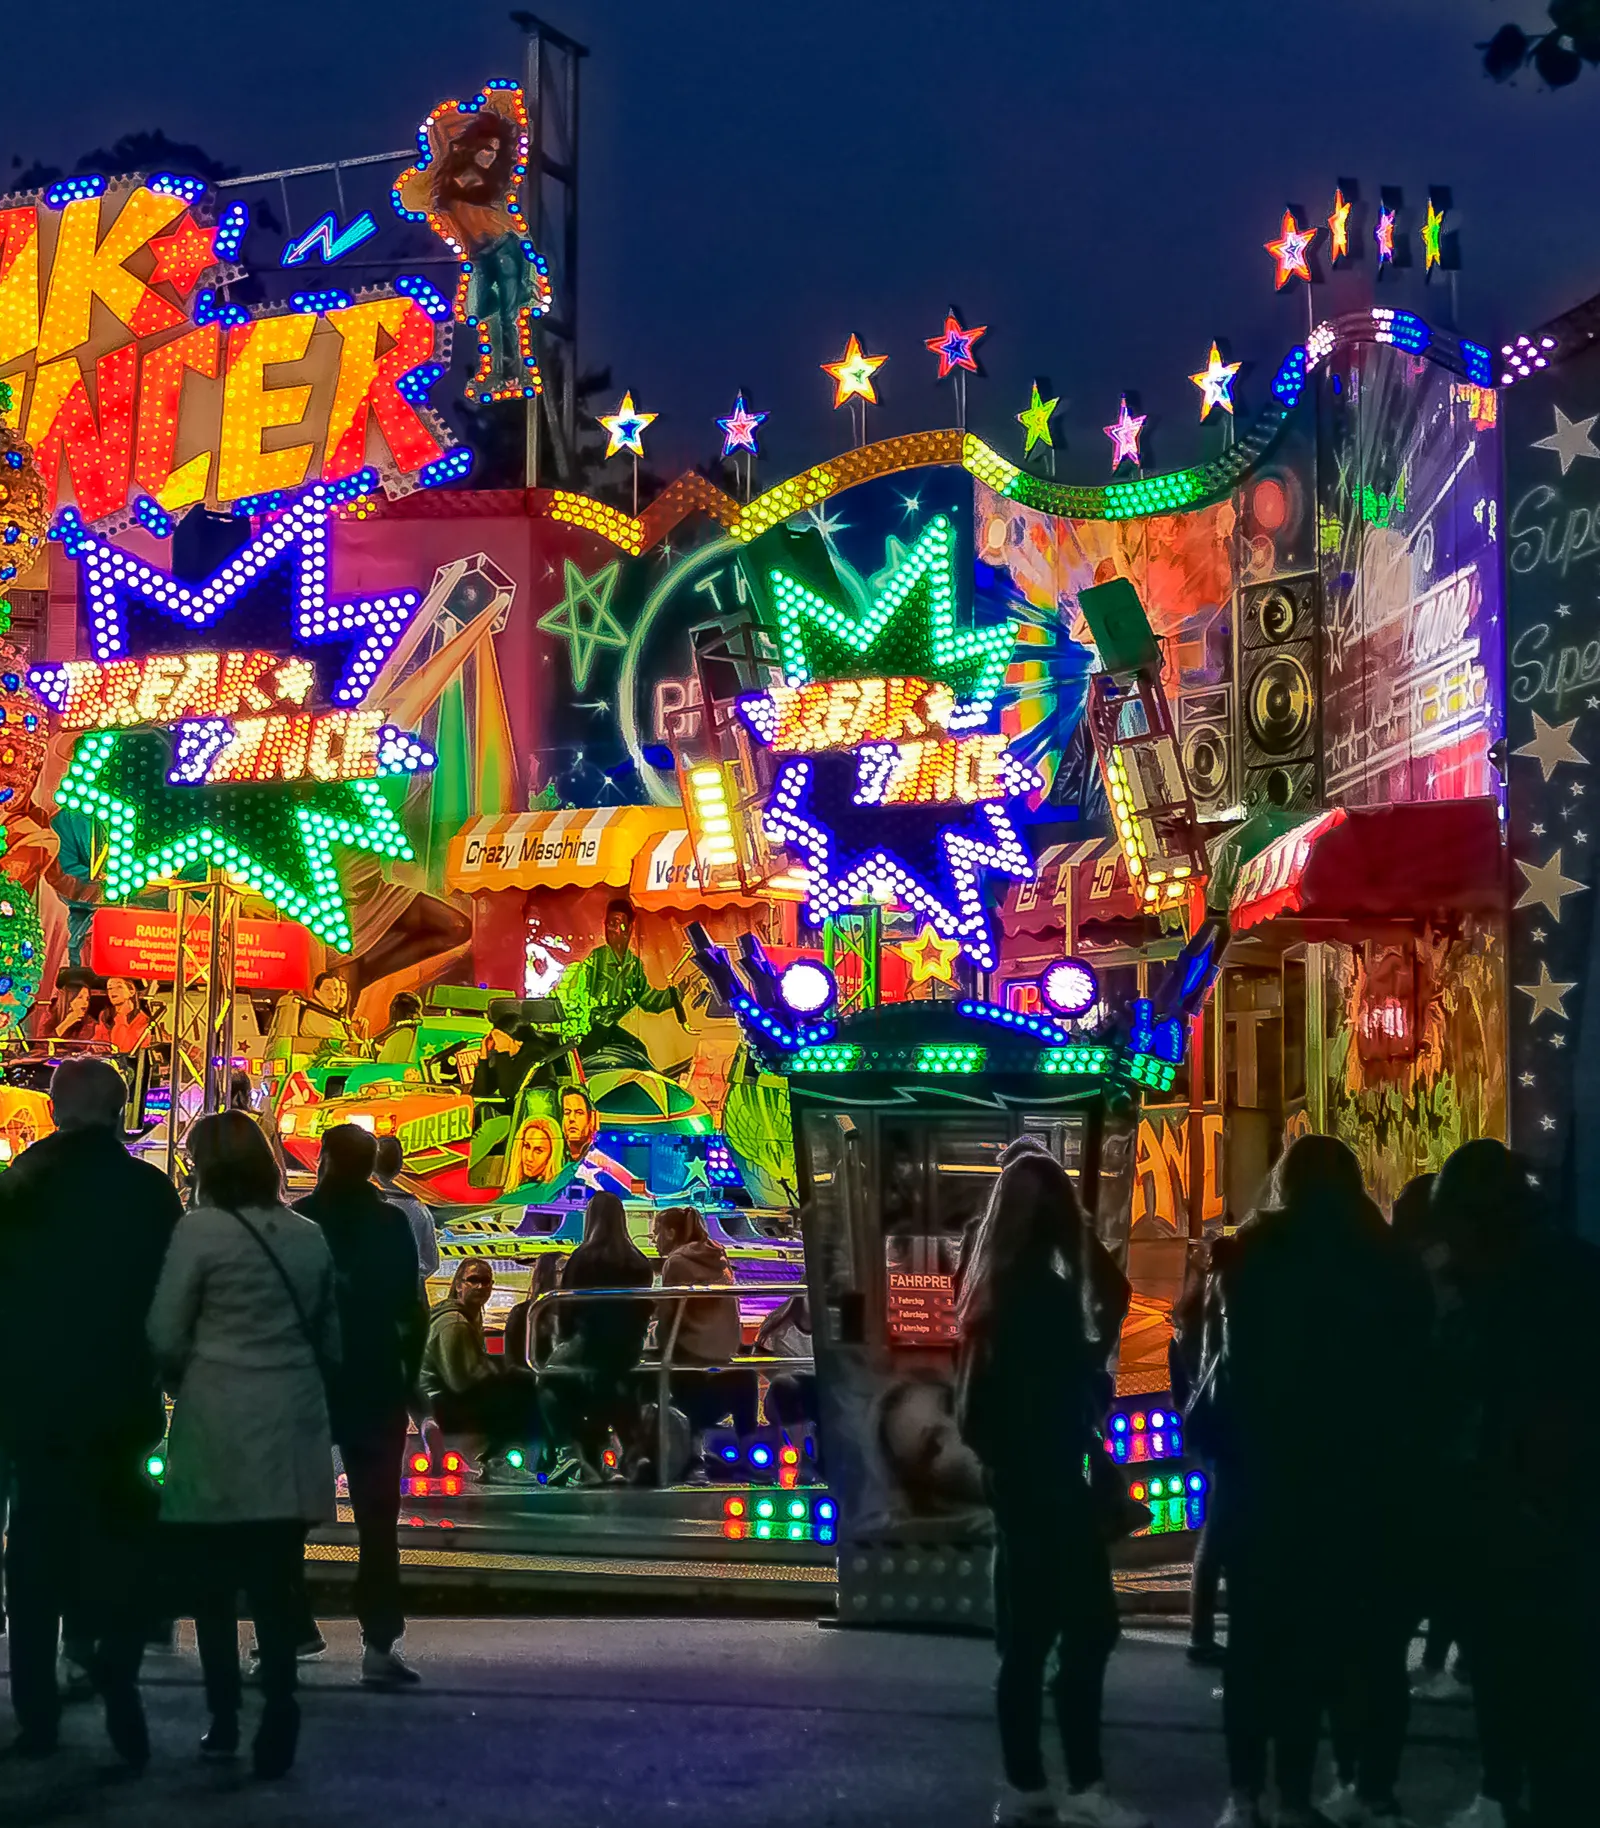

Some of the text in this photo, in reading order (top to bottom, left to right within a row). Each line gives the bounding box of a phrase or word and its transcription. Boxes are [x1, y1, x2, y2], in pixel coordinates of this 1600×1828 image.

[465, 835, 596, 868] Crazy Maschine
[398, 1108, 470, 1154] SURFER
